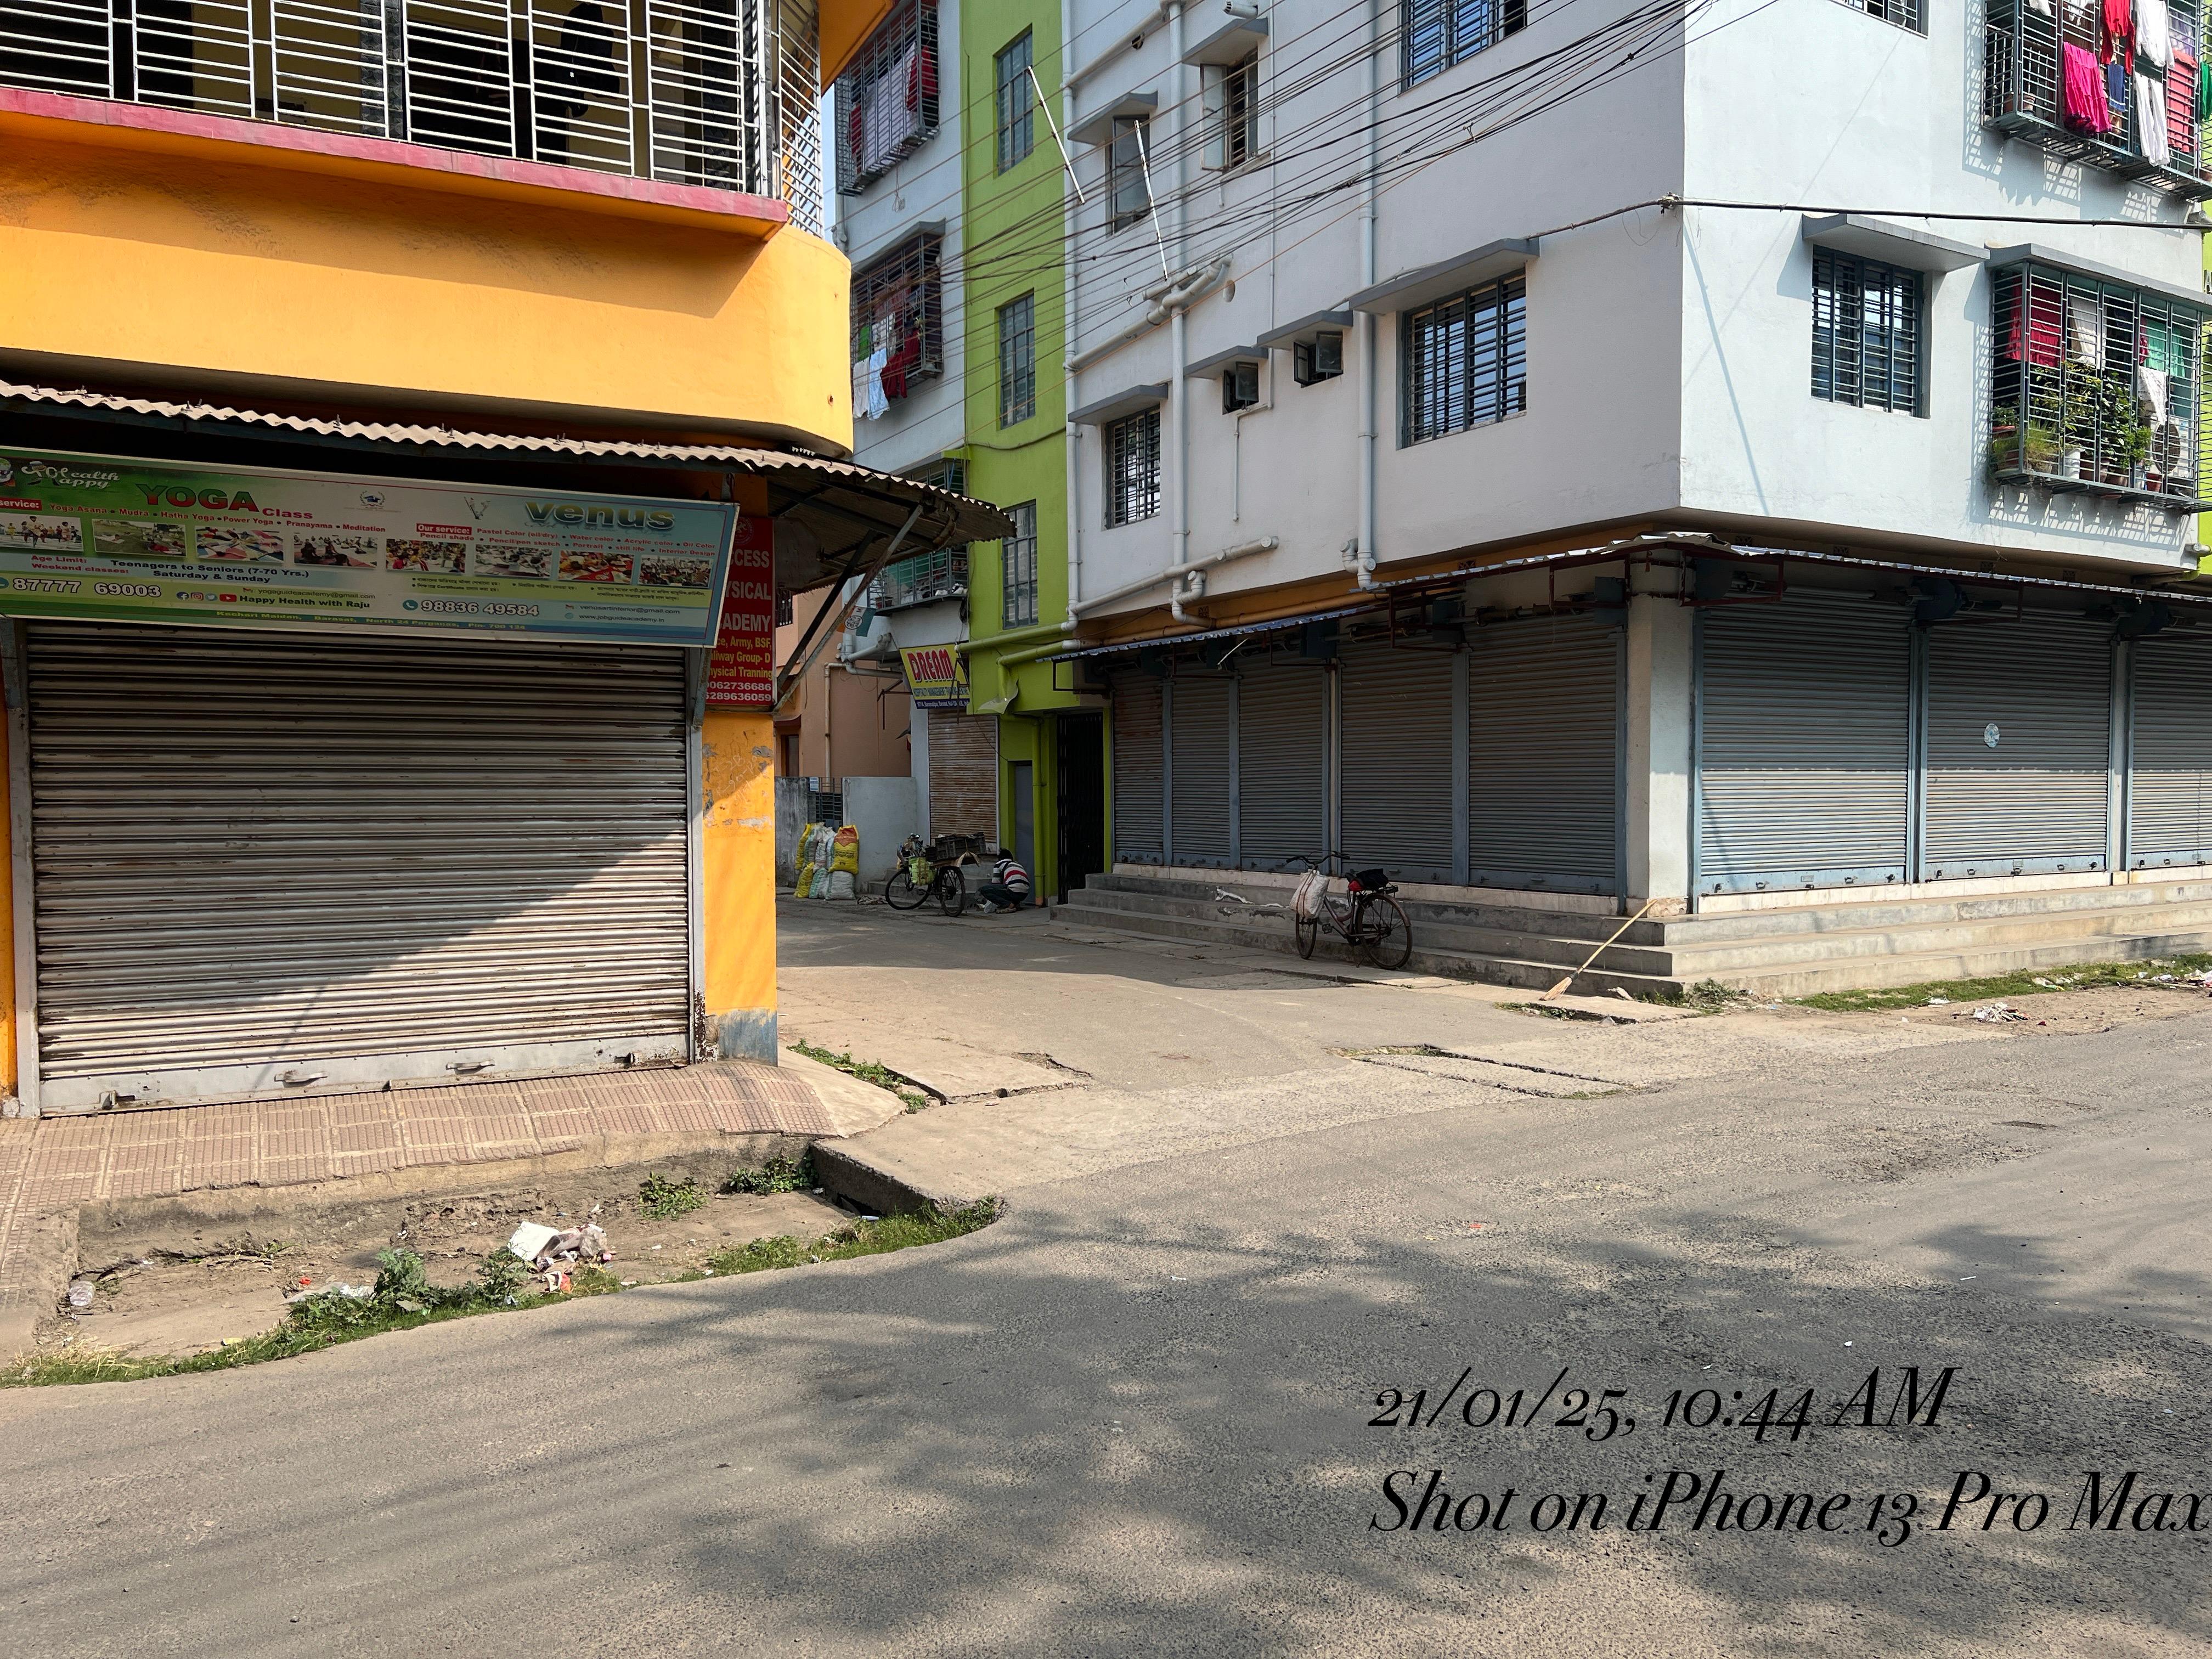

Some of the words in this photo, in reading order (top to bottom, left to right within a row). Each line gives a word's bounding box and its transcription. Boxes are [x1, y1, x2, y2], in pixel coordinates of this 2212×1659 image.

[135, 483, 259, 512] YOGA
[262, 508, 313, 519] Class
[50, 504, 74, 512] Yoga
[193, 513, 215, 522] Yoga
[223, 516, 250, 524] Power
[253, 517, 273, 526] Yoga
[286, 520, 333, 530] Pranayama
[342, 524, 386, 533] Meditation
[526, 501, 675, 530] venus
[435, 526, 470, 534] service:
[489, 537, 531, 545] Pencil/pen
[111, 560, 177, 571] Teenagers
[198, 565, 246, 573] Seniors
[248, 567, 278, 575] (7-70
[281, 569, 309, 578] Yrs.)
[153, 571, 208, 580] Saturday
[226, 574, 270, 584] Sunday
[13, 578, 82, 593] 87777
[94, 582, 162, 597] 69003
[258, 588, 376, 599] yogaguideacademy@gmail.com
[240, 595, 275, 605] Happy
[279, 597, 316, 606] Health
[421, 600, 479, 614] 98836
[483, 603, 539, 617] 49584
[580, 605, 680, 614] venusartinterior@gmail.com
[579, 614, 665, 623] www.jobguideacademy.in
[720, 613, 771, 632] ADEMY
[730, 635, 753, 650] Army,
[754, 637, 772, 651] BSF,
[736, 651, 763, 665] Group-
[764, 652, 771, 663] D
[907, 649, 955, 682] DREAM
[738, 666, 772, 681] Tranning
